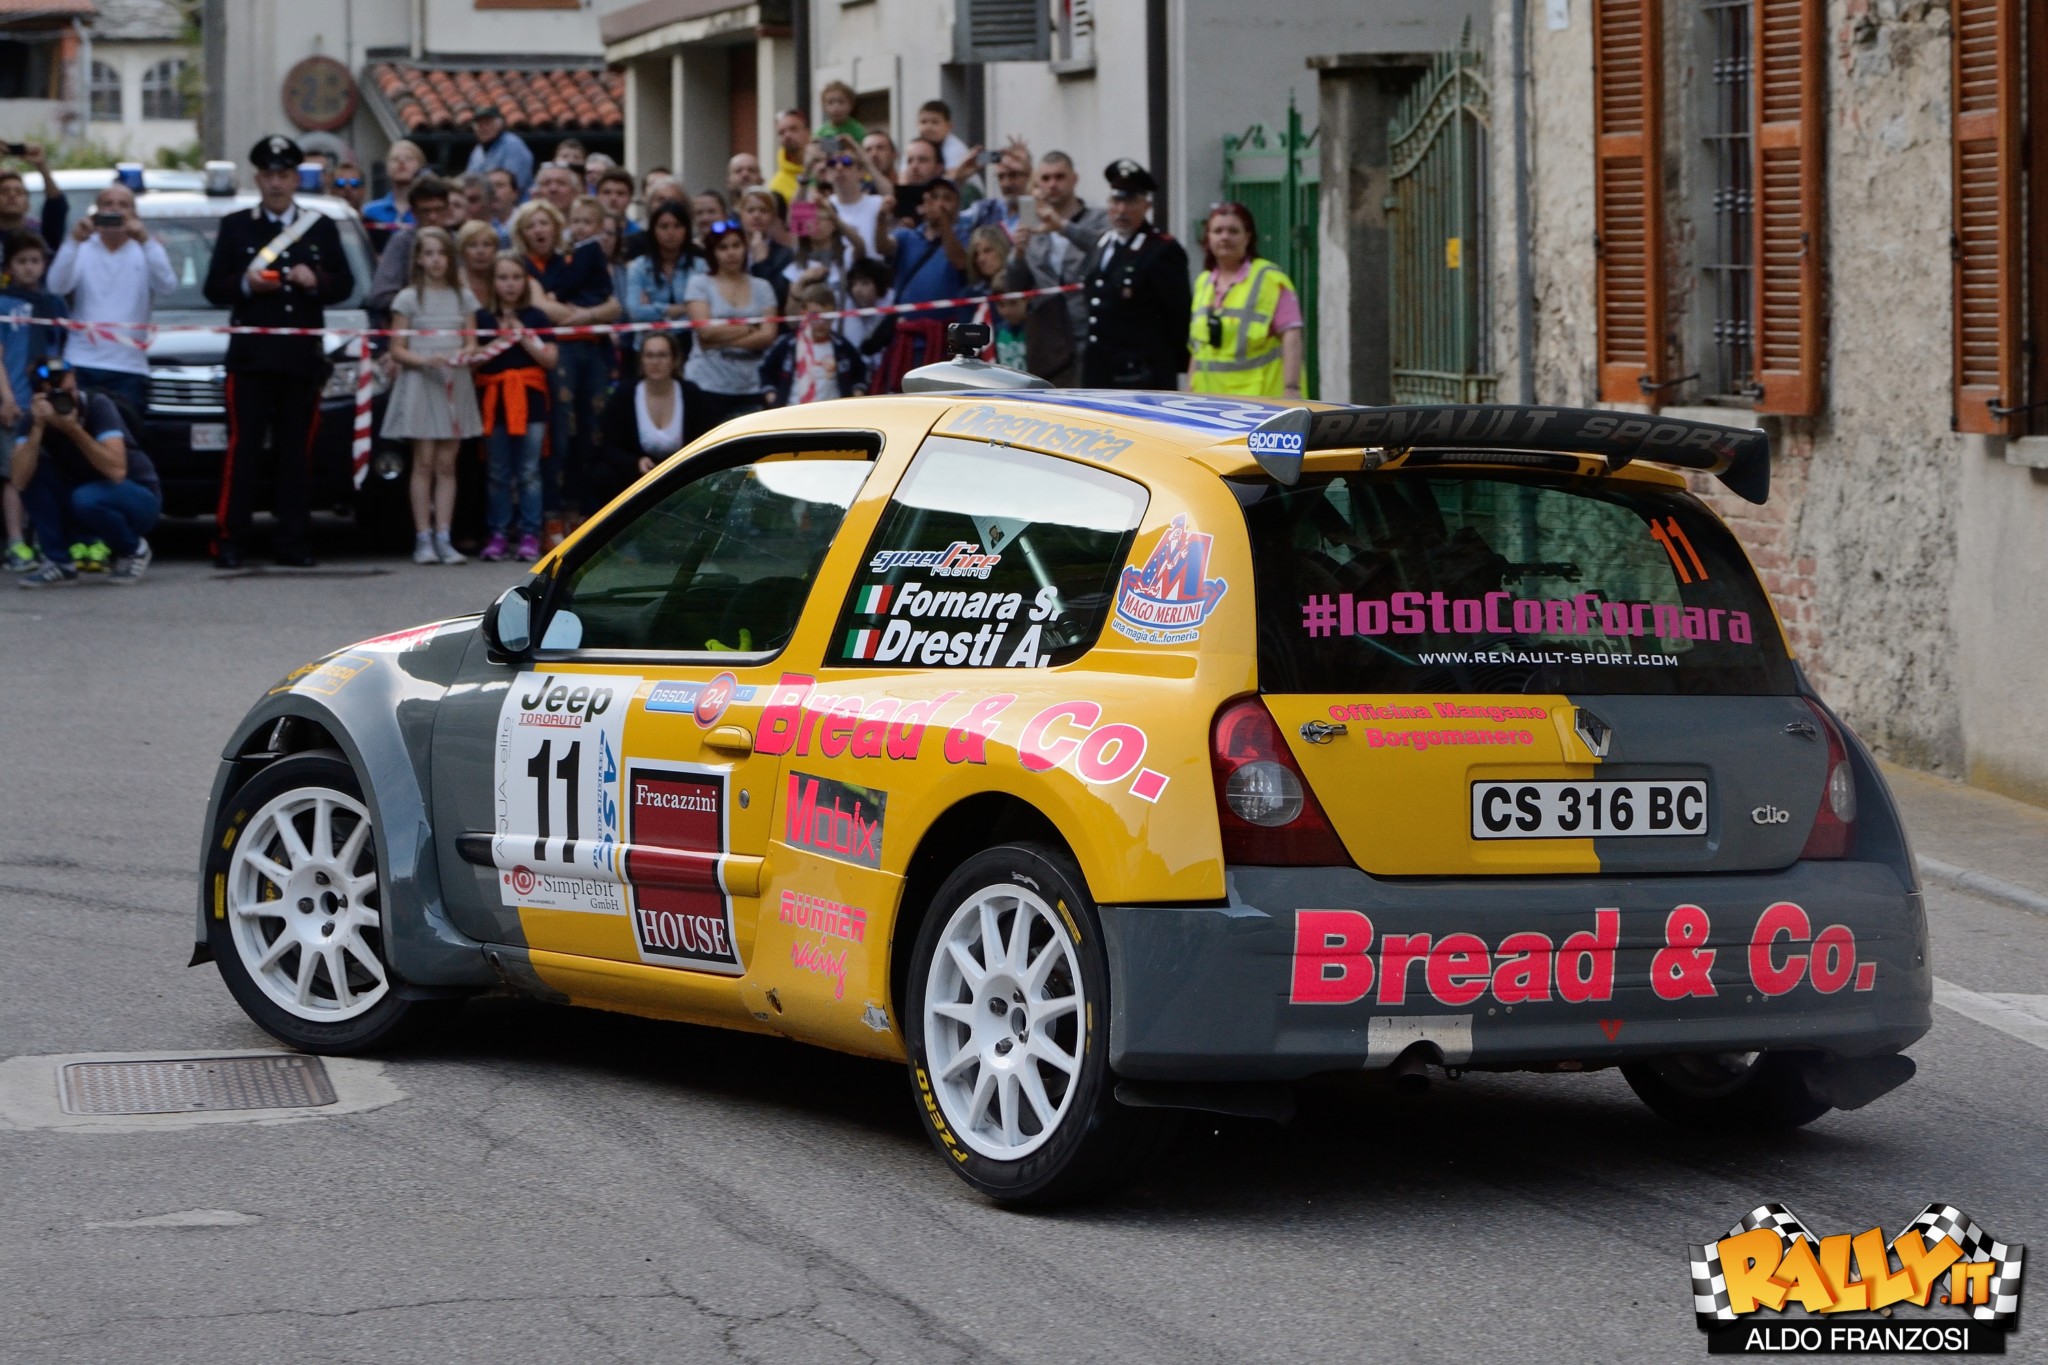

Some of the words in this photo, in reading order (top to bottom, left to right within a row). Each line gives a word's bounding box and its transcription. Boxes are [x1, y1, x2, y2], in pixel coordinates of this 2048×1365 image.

[1249, 432, 1302, 453] sparco
[1312, 409, 1558, 444] RENAULT
[1575, 416, 1759, 455] SPORT
[1650, 516, 1709, 584] 11
[930, 566, 992, 579] racing
[890, 582, 1022, 620] Fornara
[1028, 585, 1059, 622] S.
[1121, 594, 1154, 620] MAGO
[1153, 604, 1202, 623] MERLINI
[874, 619, 1008, 666] Dresti
[1006, 625, 1052, 668] A.
[1112, 619, 1126, 633] una
[1125, 627, 1148, 641] magia
[1418, 652, 1679, 667] WWW.RENAULT-SPORT.COM
[521, 675, 614, 722] Jeep
[651, 689, 697, 704] OSSOLA
[701, 688, 728, 709] 24
[1328, 703, 1433, 722] Officina
[1433, 702, 1548, 722] Mangano
[520, 713, 583, 726] TOROAUTO
[753, 672, 964, 761] Bread
[943, 693, 1019, 765] &
[1018, 700, 1170, 804] Co.
[1365, 728, 1534, 750] Borgomanero
[528, 739, 581, 863] 11
[636, 784, 717, 813] Fracazzini
[1481, 786, 1542, 831] CS
[1557, 786, 1634, 831] 316
[1649, 786, 1703, 830] BC
[1752, 804, 1790, 825] Clio
[785, 773, 878, 861] Mobix
[543, 874, 614, 900] Simplebit
[590, 898, 620, 911] GmbH
[779, 890, 868, 943] RUNNER
[637, 908, 732, 957] HOUSE
[790, 933, 848, 1001] racing
[1289, 907, 1621, 1006] Bread
[1650, 903, 1719, 999] &
[1747, 901, 1877, 996] Co.
